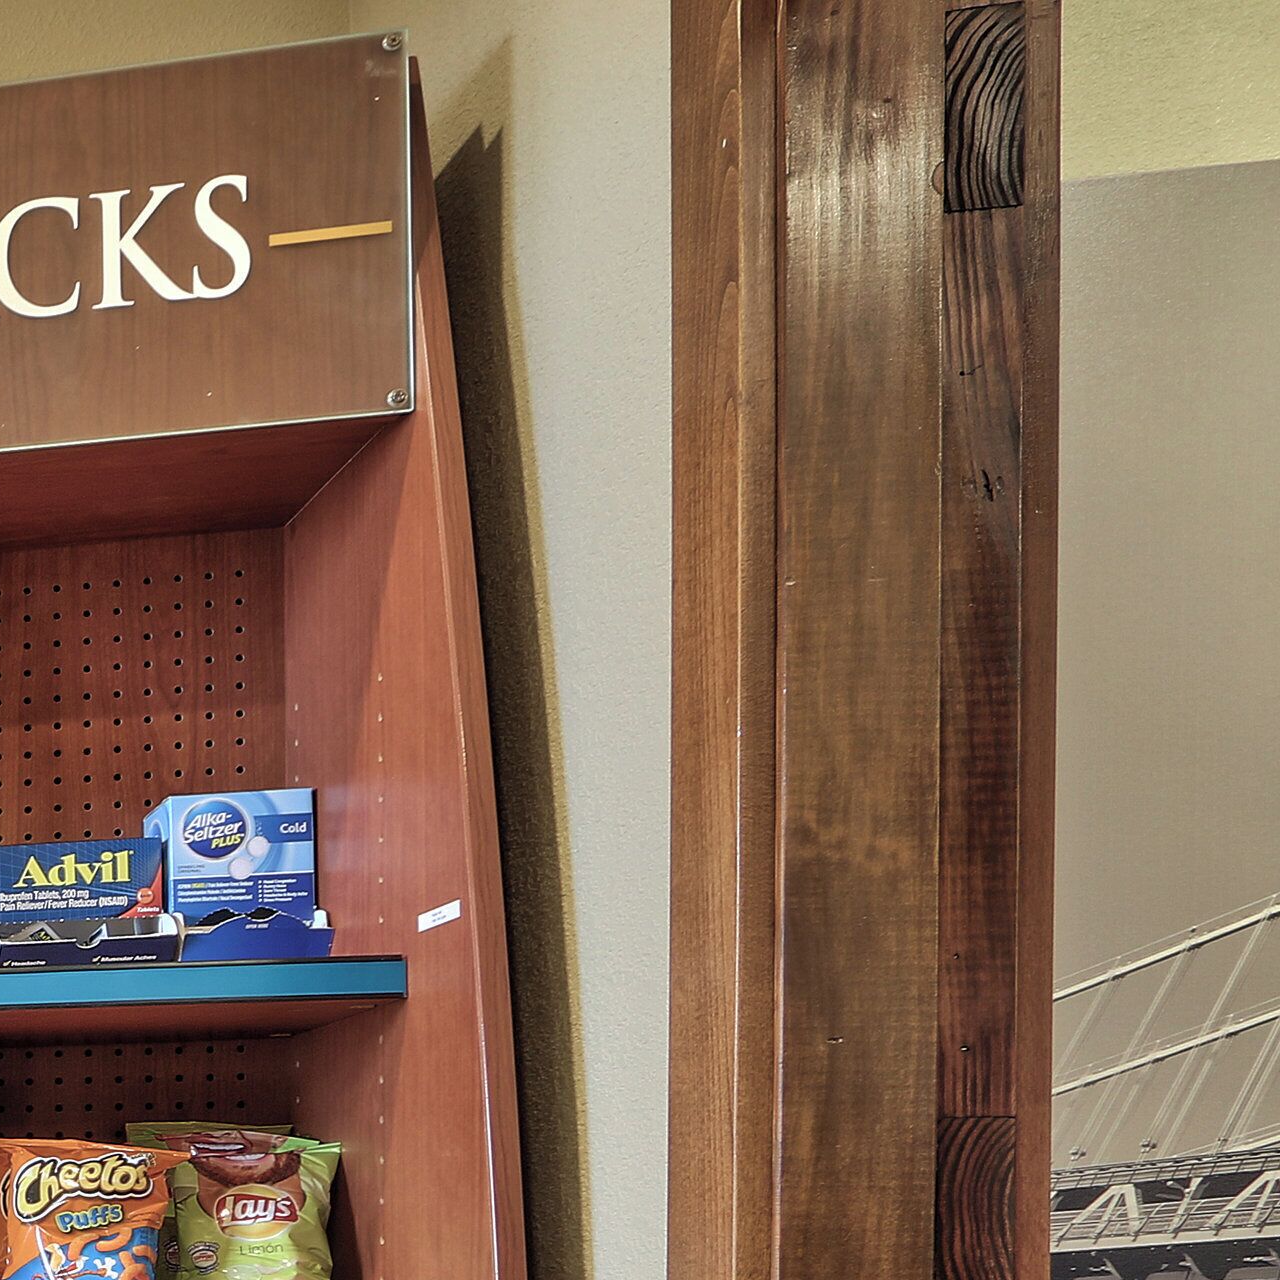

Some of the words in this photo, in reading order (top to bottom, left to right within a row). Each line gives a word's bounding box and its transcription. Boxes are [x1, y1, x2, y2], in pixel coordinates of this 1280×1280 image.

[186, 811, 232, 830] Alka-
[279, 822, 307, 833] Cold
[184, 821, 244, 844] Seltzer
[211, 834, 243, 849] PLUS
[13, 850, 134, 888] Advil
[0, 891, 33, 901] Ibuprofen
[34, 890, 61, 901] Tablets,
[63, 889, 76, 899] 200
[77, 890, 89, 900] mg
[11, 959, 46, 967] Headache
[15, 1154, 150, 1220] Cheetos
[57, 1204, 122, 1232] Puffs
[218, 1196, 292, 1226] Lay's
[240, 1243, 284, 1255] Limón
